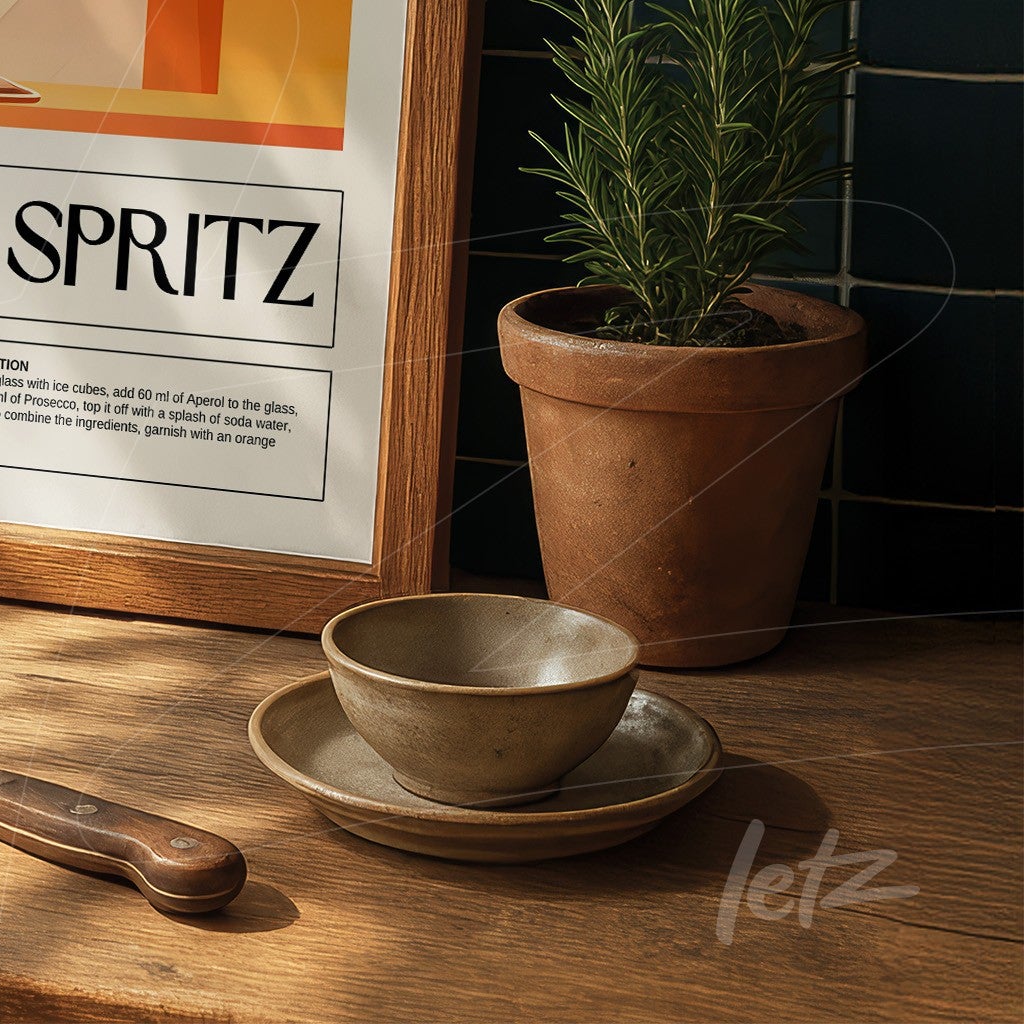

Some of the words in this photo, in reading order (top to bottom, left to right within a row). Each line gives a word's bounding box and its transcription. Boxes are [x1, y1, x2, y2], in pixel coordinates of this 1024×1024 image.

[7, 200, 321, 308] SPRITZ
[10, 393, 22, 404] of
[24, 393, 79, 412] Prosecco,
[83, 401, 101, 415] top
[104, 401, 111, 414] it
[114, 403, 129, 415] off
[131, 405, 154, 418] with
[157, 409, 165, 419] a
[168, 409, 206, 423] splash
[209, 413, 221, 424] of
[224, 415, 252, 428] soda
[256, 419, 291, 433] water,
[27, 378, 50, 390] with
[52, 379, 69, 392] ice
[72, 383, 109, 398] cubes,
[112, 386, 135, 399] add
[138, 388, 152, 401] 60
[155, 391, 169, 402] ml
[172, 392, 184, 404] of
[186, 394, 225, 408] Aperol
[228, 398, 239, 409] to
[242, 398, 261, 412] the
[264, 401, 298, 417] glass,
[4, 410, 52, 424] combine
[54, 414, 73, 426] the
[75, 415, 140, 435] ingredients,
[144, 425, 187, 438] garnish
[190, 428, 213, 441] with
[217, 432, 232, 443] an
[235, 434, 276, 449] orange
